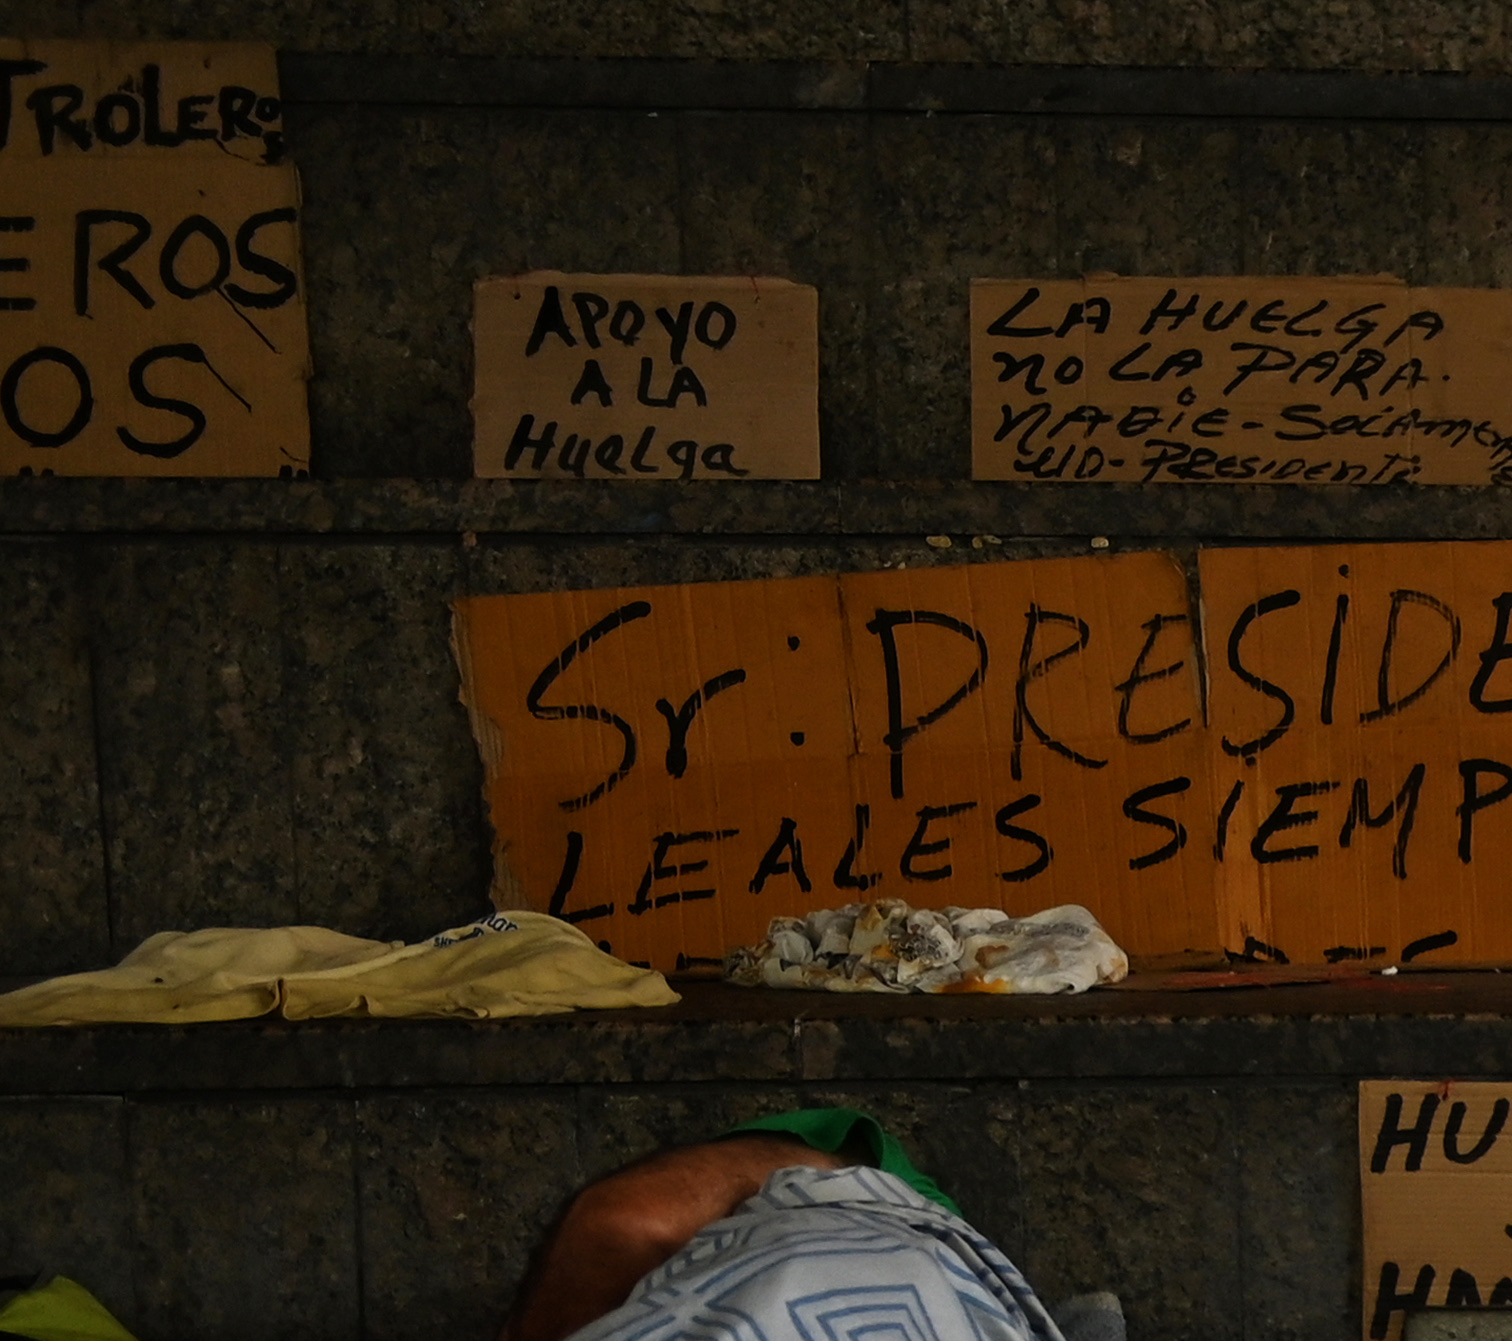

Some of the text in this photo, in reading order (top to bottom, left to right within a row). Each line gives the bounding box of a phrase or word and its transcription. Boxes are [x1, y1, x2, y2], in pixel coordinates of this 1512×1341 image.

[526, 286, 738, 364] APOYO
[987, 287, 1444, 355] LA HUELGA
[570, 357, 708, 409] A LA
[1108, 342, 1203, 382] LA
[0, 343, 207, 458] OS
[546, 793, 1055, 925] LEALES
